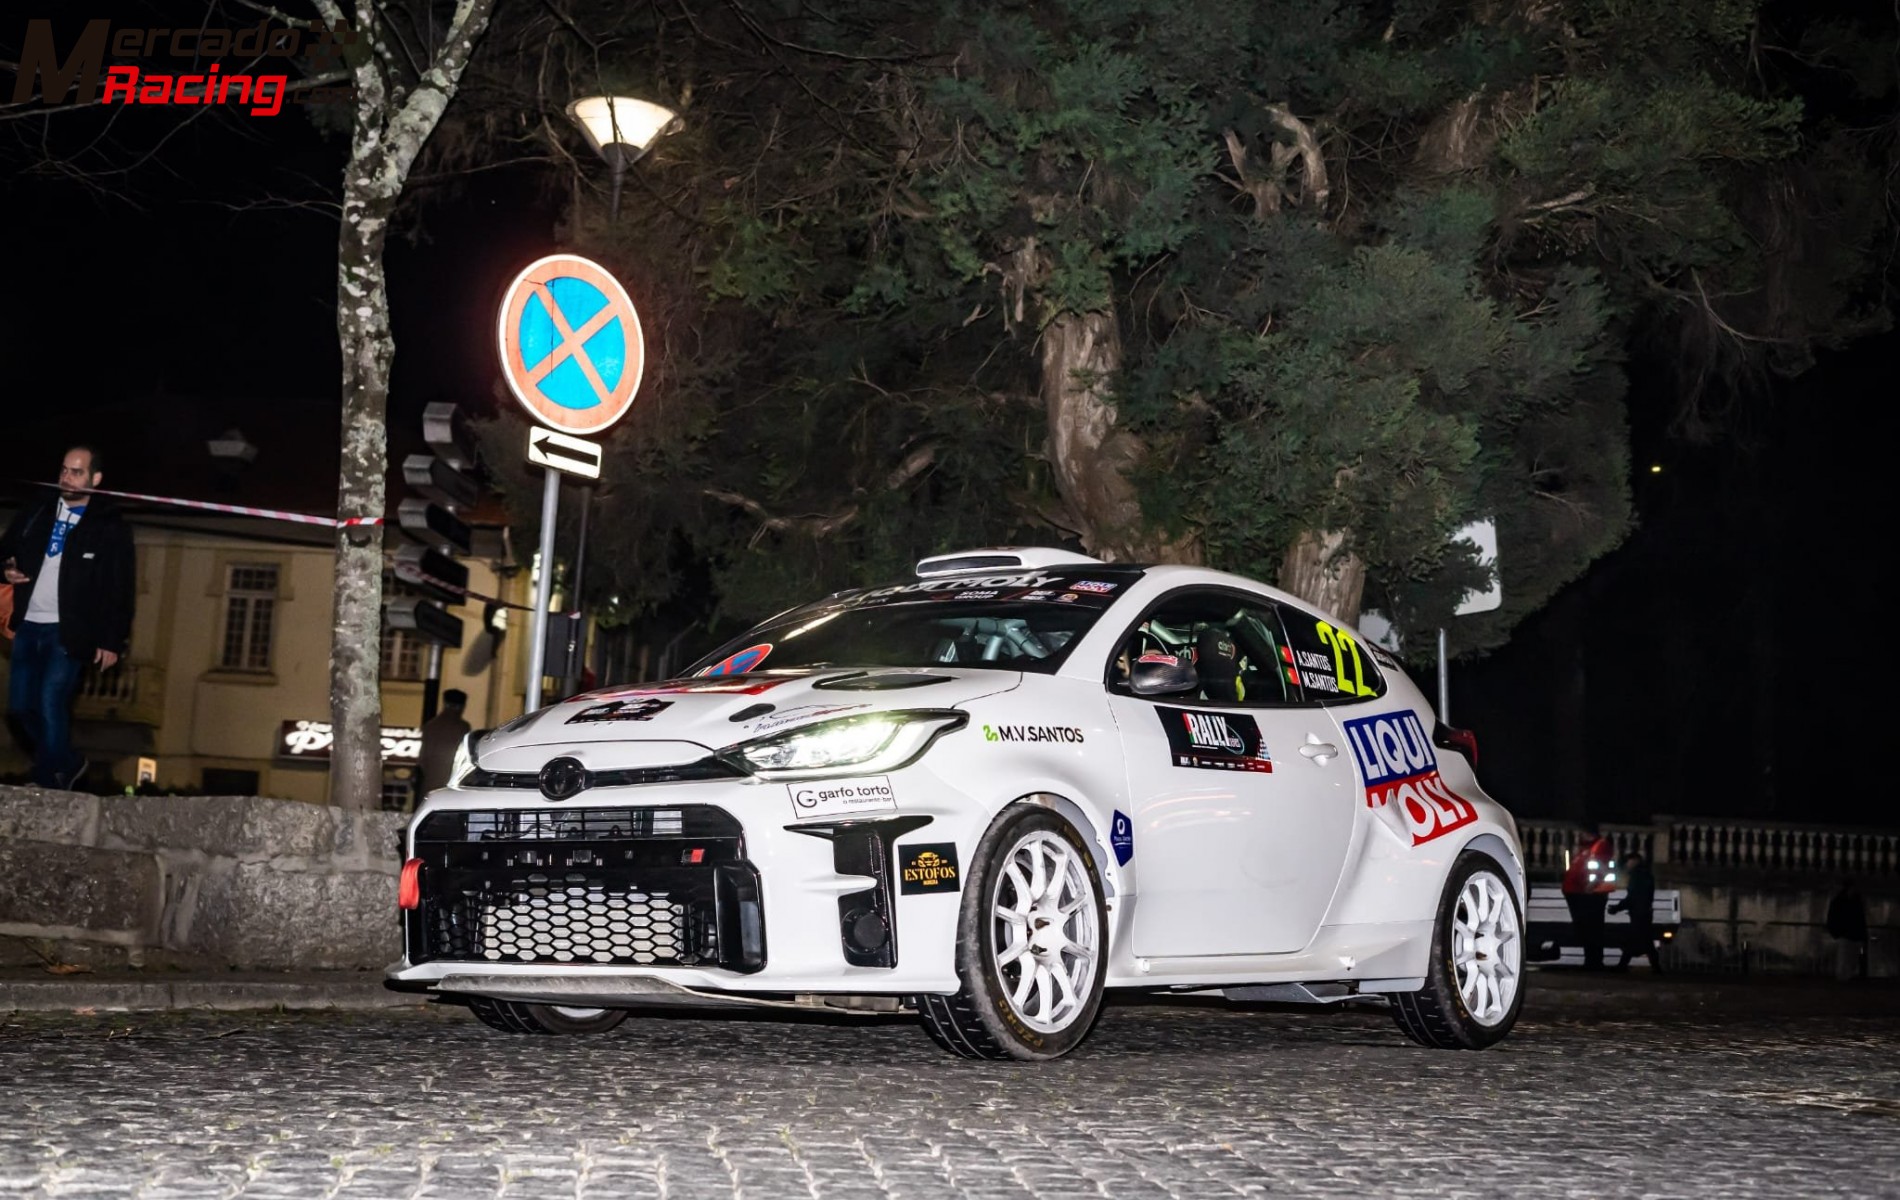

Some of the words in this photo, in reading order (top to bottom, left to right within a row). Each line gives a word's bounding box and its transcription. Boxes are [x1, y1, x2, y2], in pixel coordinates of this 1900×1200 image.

[1296, 650, 1332, 671] A.SANTOS
[1316, 620, 1377, 697] 22
[1301, 670, 1339, 693] M.SANTOS
[1184, 713, 1230, 747] RALLY
[1350, 715, 1434, 780] LIQUI
[818, 787, 854, 801] garfo
[857, 785, 890, 796] torto
[904, 866, 956, 881] ESTOFOS
